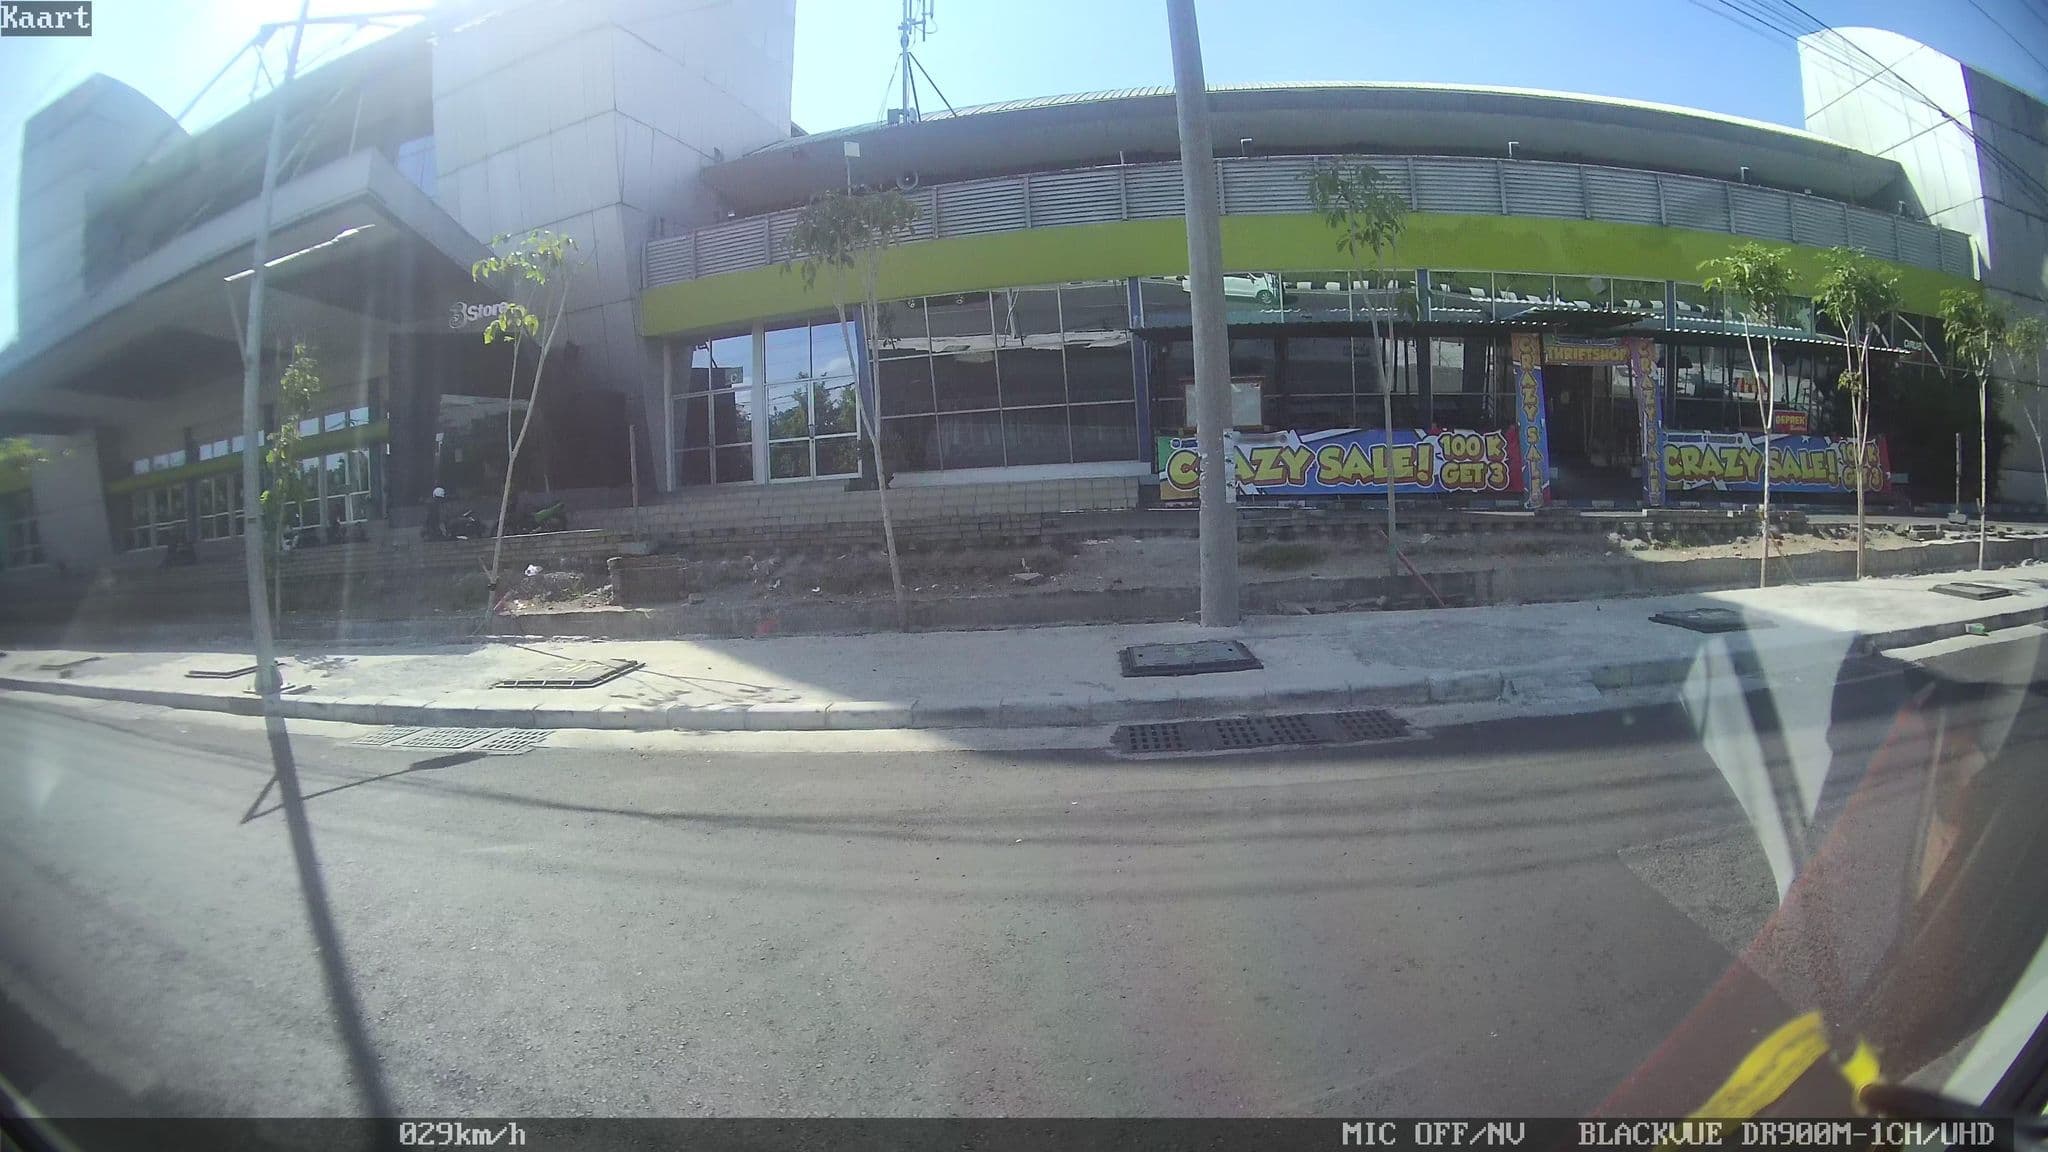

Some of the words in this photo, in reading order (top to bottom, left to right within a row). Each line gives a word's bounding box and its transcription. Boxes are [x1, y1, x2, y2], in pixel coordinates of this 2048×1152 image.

[1546, 345, 1629, 362] THRIFTSHOP
[1519, 336, 1538, 422] CRAZY
[1168, 446, 1317, 487] CAZY
[1317, 443, 1434, 487] SALE!
[1438, 433, 1484, 462] 100
[1484, 434, 1507, 461] K
[1526, 426, 1544, 508] SALE
[1664, 444, 1762, 482] CRAZY
[1767, 447, 1839, 487] SALE!
[1440, 461, 1487, 490] GET
[1486, 461, 1508, 490] 3
